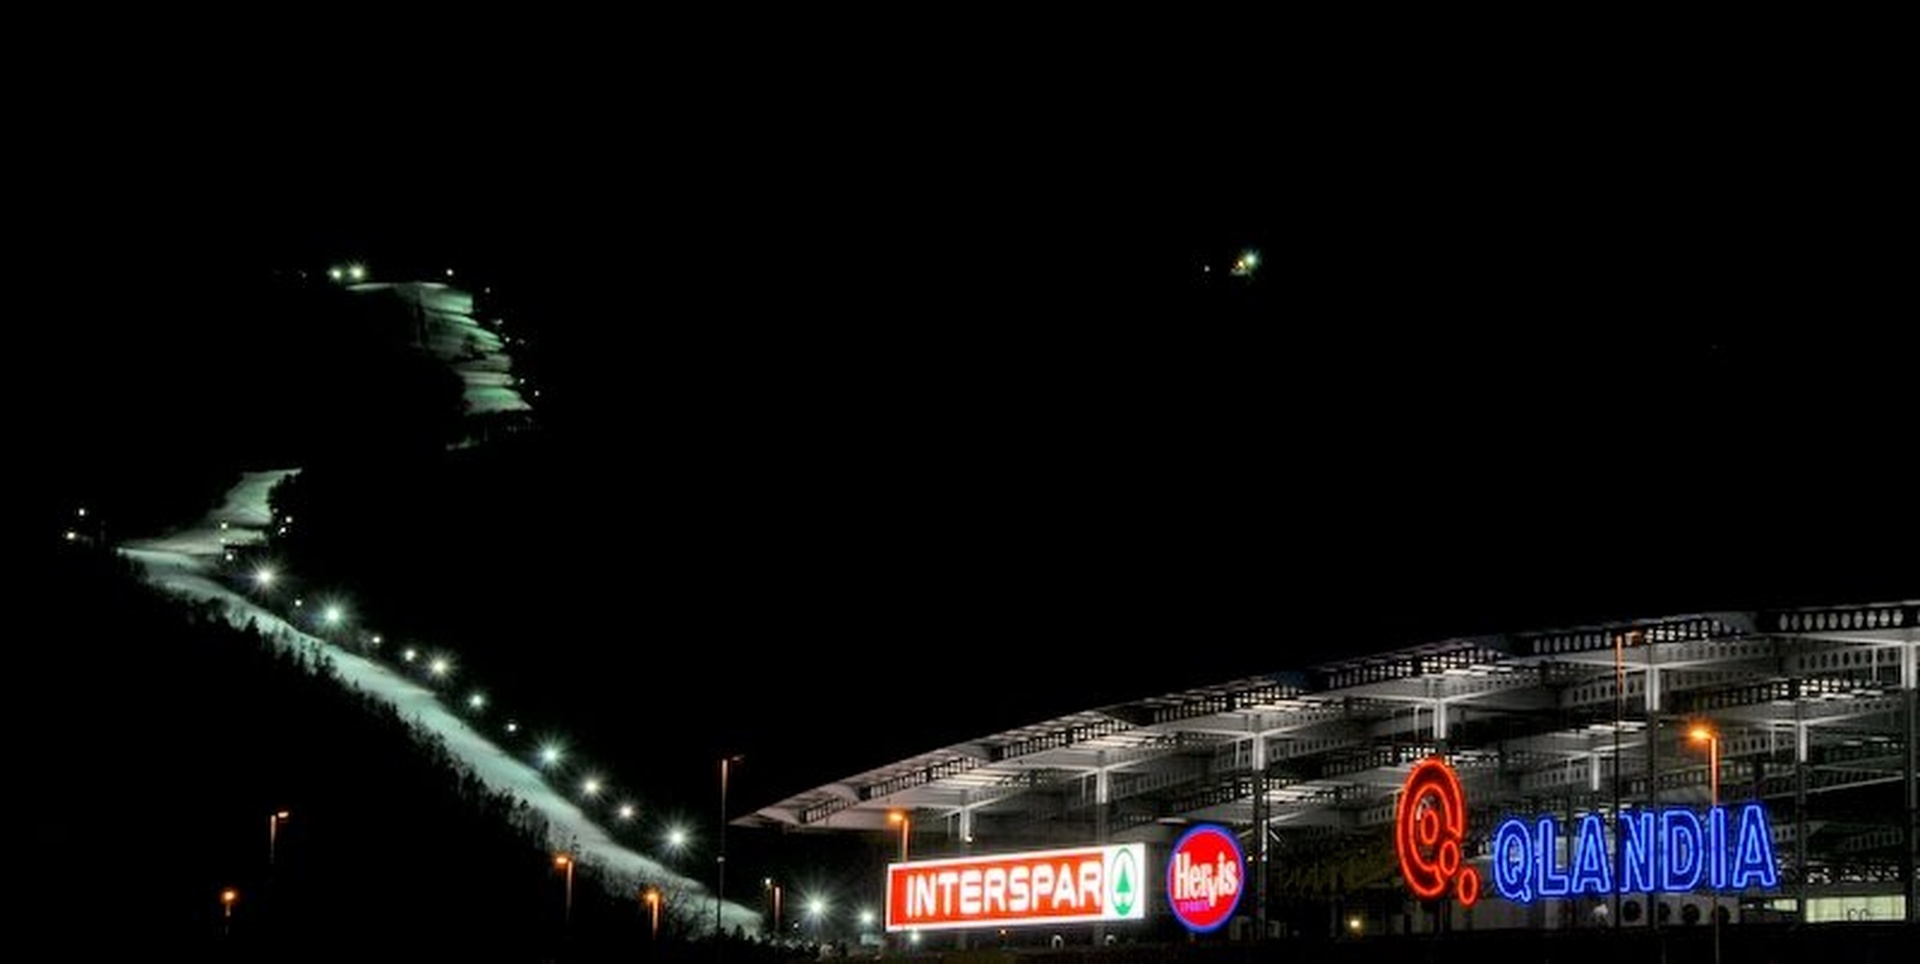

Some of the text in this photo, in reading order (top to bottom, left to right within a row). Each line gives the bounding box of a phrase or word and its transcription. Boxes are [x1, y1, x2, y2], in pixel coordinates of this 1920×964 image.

[1174, 851, 1237, 907] Hervis
[1495, 804, 1777, 902] QLANDIA
[906, 861, 1102, 917] INTERSPAR
